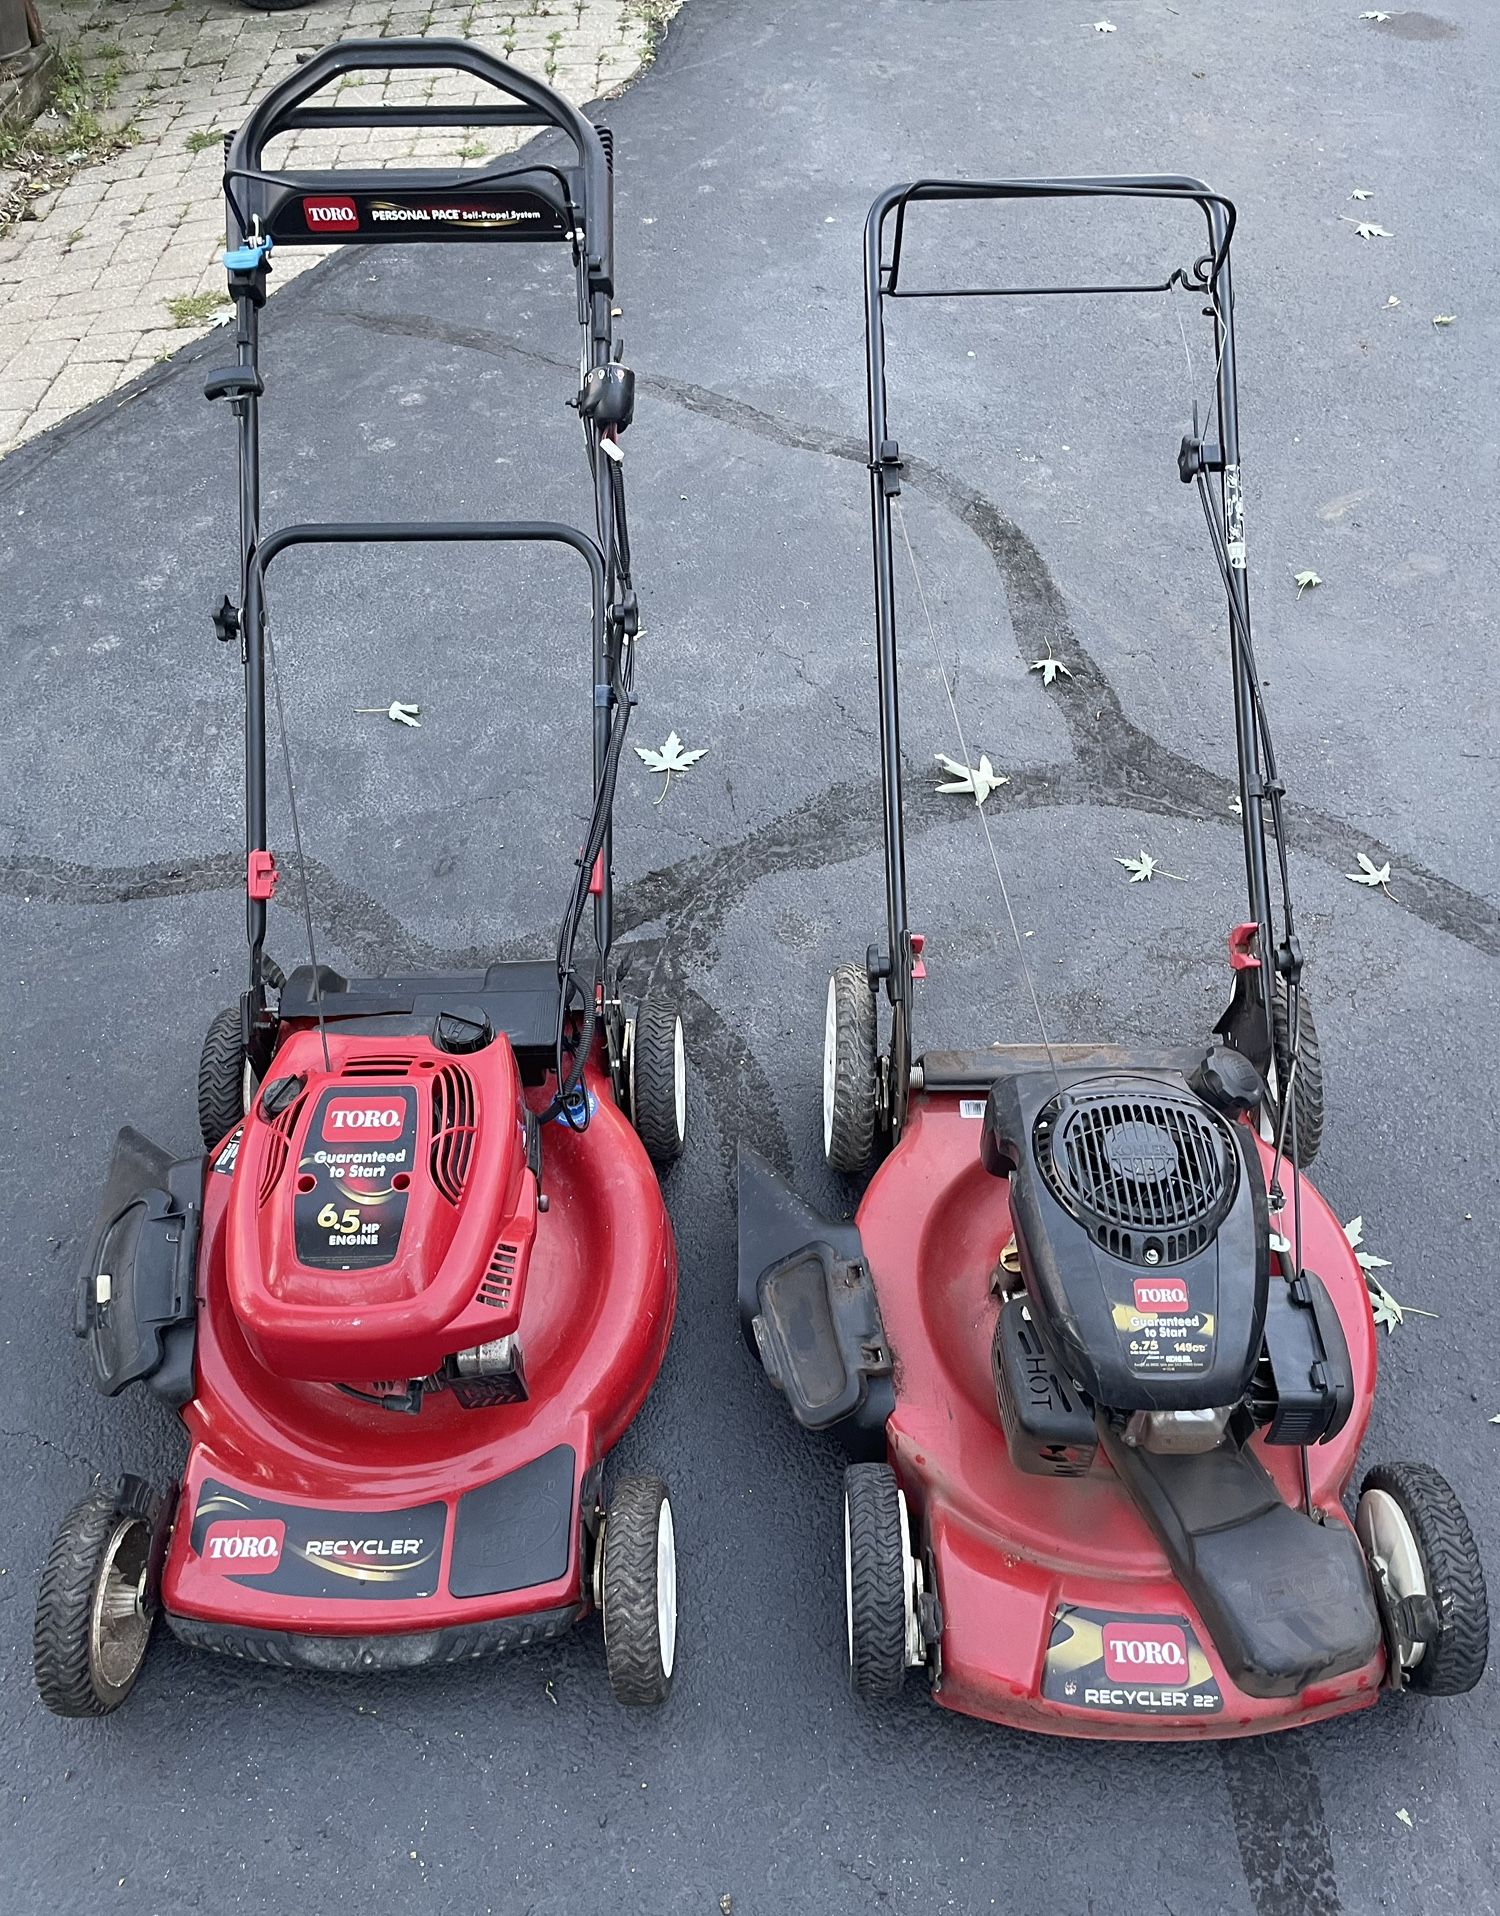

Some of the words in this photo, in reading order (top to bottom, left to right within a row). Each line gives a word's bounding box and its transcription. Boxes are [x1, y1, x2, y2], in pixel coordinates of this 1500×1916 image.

[371, 210, 431, 221] PERSONAL
[431, 209, 460, 220] PACE
[462, 210, 510, 220] Self-Propel
[511, 210, 541, 220] System
[314, 1149, 406, 1164] Guaranteed
[329, 1167, 345, 1178] to
[348, 1165, 386, 1178] Start
[317, 1203, 361, 1233] 6.5
[361, 1223, 381, 1234] HP
[328, 1234, 379, 1246] ENGINE
[1130, 1315, 1200, 1327] Guaranteed
[1144, 1327, 1157, 1338] to
[1159, 1327, 1187, 1338] Start
[1129, 1340, 1159, 1351] 6.75
[1025, 1357, 1053, 1411] HOT
